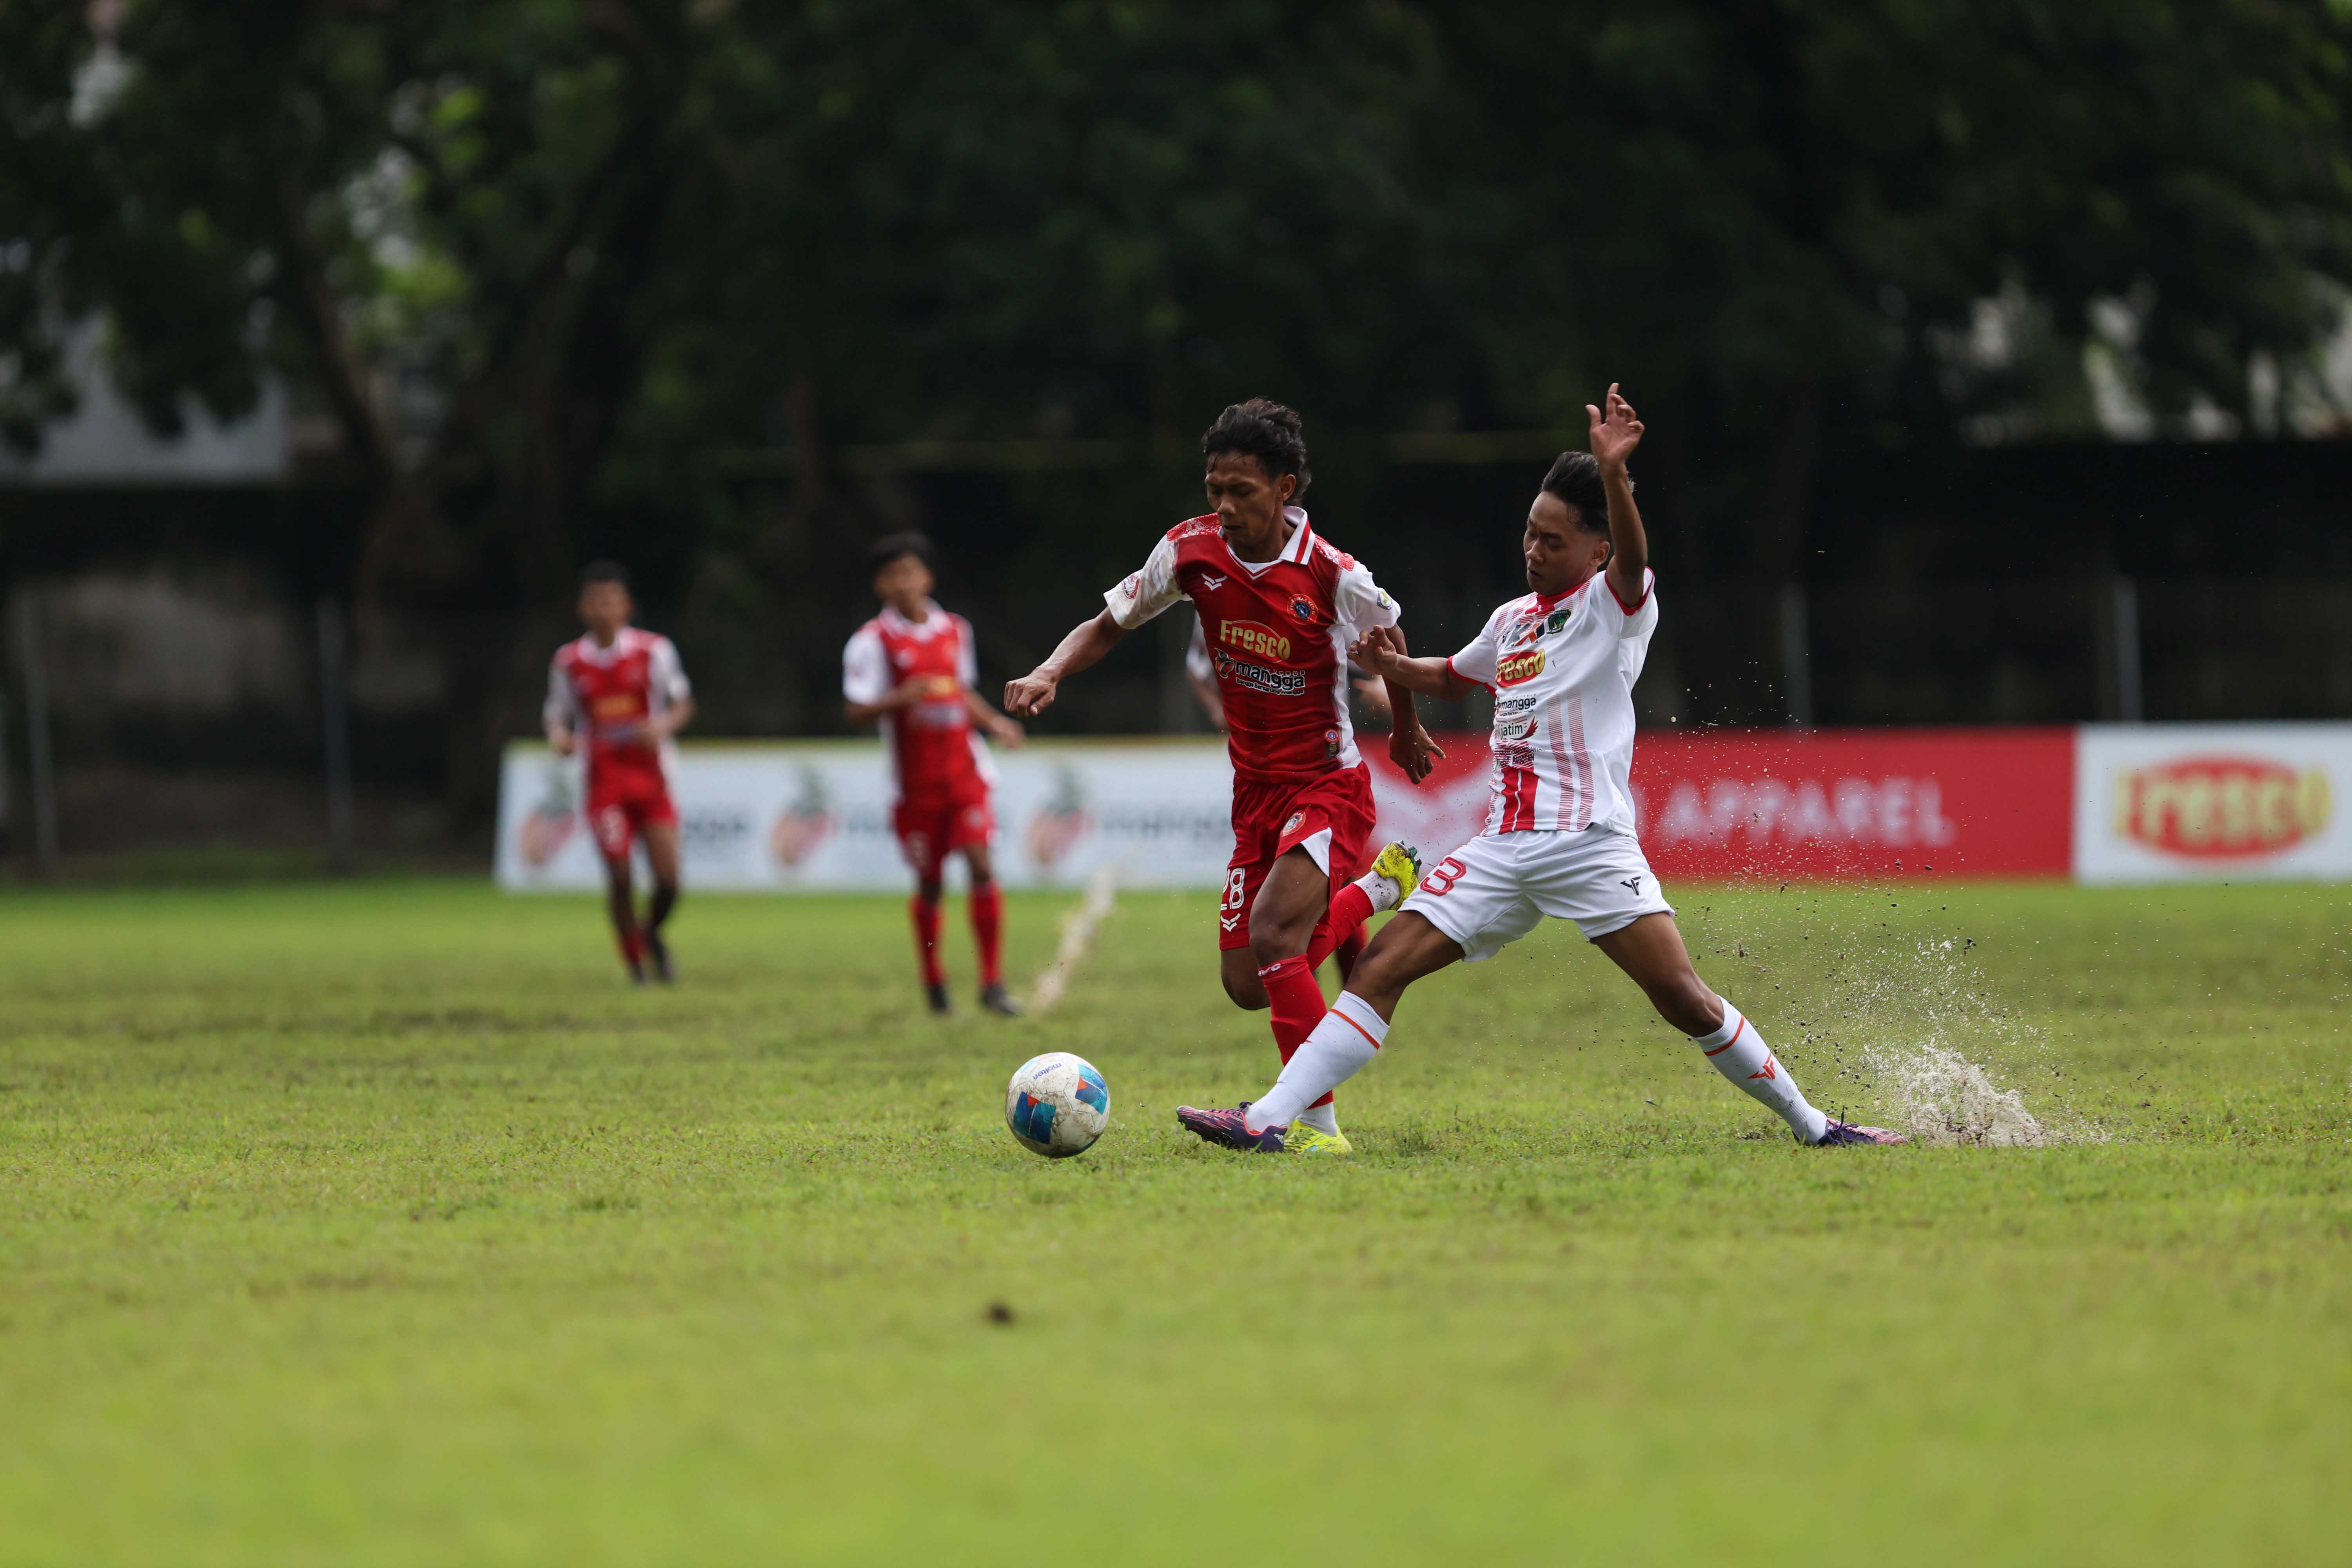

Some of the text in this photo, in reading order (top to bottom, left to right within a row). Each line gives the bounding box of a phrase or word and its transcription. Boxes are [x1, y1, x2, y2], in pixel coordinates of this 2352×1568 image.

[1220, 619, 1290, 660] Fresco
[1235, 661, 1306, 691] mangga
[1501, 697, 1536, 710] mangga
[1660, 778, 1958, 848] APPAREL
[1033, 1063, 1062, 1080] molten
